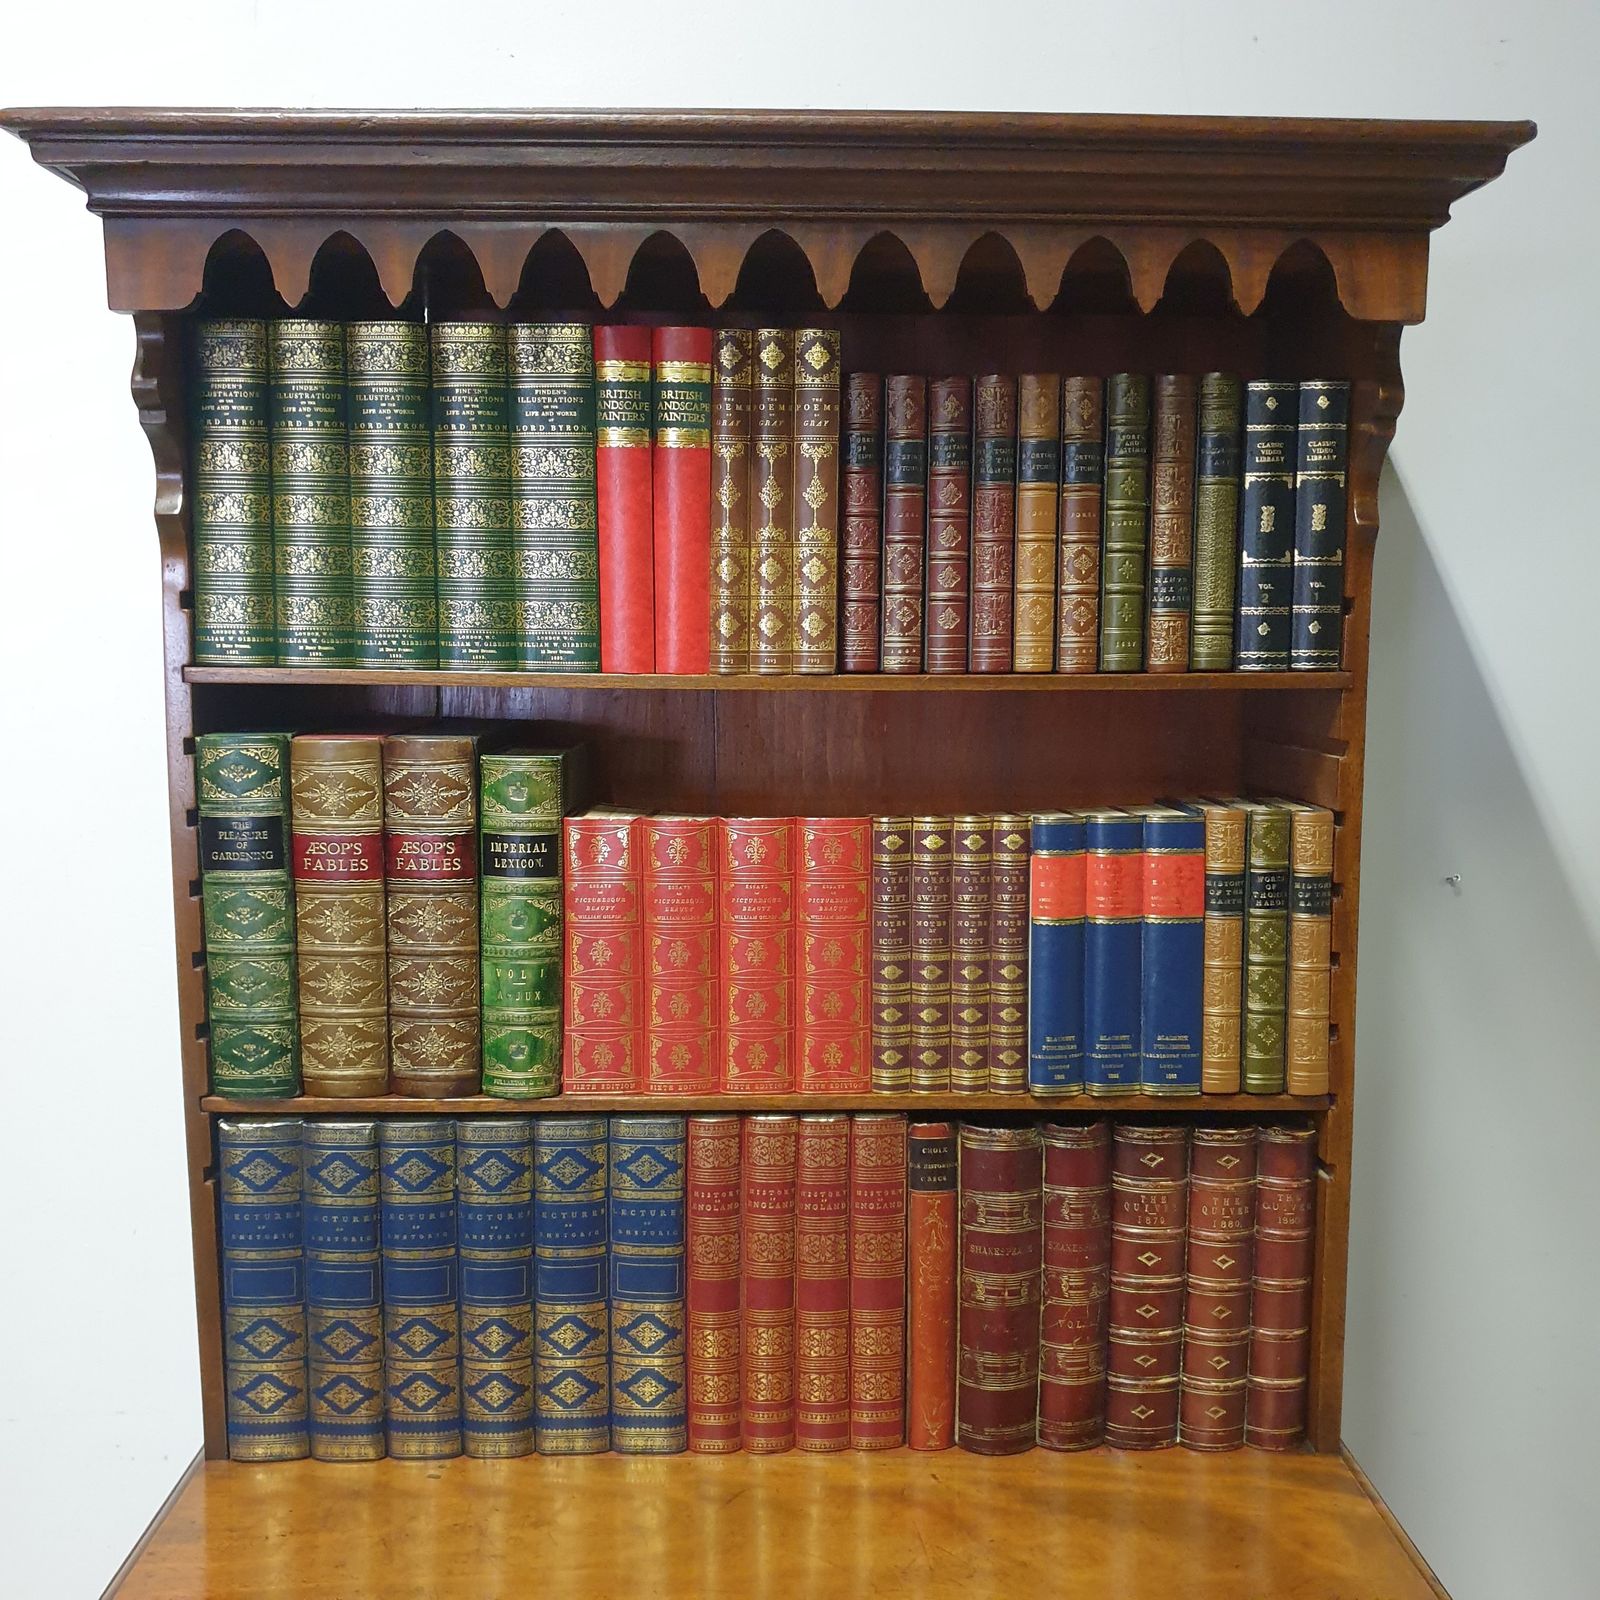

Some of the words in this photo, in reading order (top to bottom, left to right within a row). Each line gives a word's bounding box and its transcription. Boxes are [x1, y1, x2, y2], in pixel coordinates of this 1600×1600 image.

[600, 390, 641, 399] BRITISH
[660, 390, 703, 401] BRITISH
[518, 396, 584, 404] ILLUSTRATIONS
[598, 400, 650, 411] ANDSCAPE
[657, 401, 710, 412] ANDSCAPE
[598, 412, 645, 422] PAINTERS
[658, 412, 706, 423] PAINTERS
[550, 424, 586, 432] BYRON
[1308, 440, 1336, 448] CLASSIC
[1306, 454, 1336, 462] LIBRARY
[1261, 593, 1269, 603] 2
[1314, 592, 1318, 601] 1
[232, 822, 252, 830] THE
[218, 831, 268, 840] PLEASURE
[306, 842, 362, 855] ÆSOP'S
[398, 842, 455, 854] ÆSOP'S
[490, 842, 548, 854] IMPERIAL
[212, 850, 274, 862] GARDENING
[304, 858, 368, 872] FABLES
[396, 858, 461, 871] FABLES
[494, 858, 544, 869] LEXICON.
[874, 876, 908, 884] WORKS
[914, 876, 950, 884] WORKS
[954, 876, 990, 884] WORKS
[994, 876, 1024, 884] WORK
[878, 894, 906, 902] SWIFT
[916, 894, 948, 902] SWIFT
[957, 894, 988, 902] SWIFT
[996, 894, 1026, 902] SWIFT
[678, 1082, 712, 1090] EDITION
[1140, 1196, 1167, 1204] THE
[1212, 1198, 1240, 1206] THE
[855, 1201, 902, 1210] ENGLAND
[1202, 1205, 1249, 1216] QUIVER
